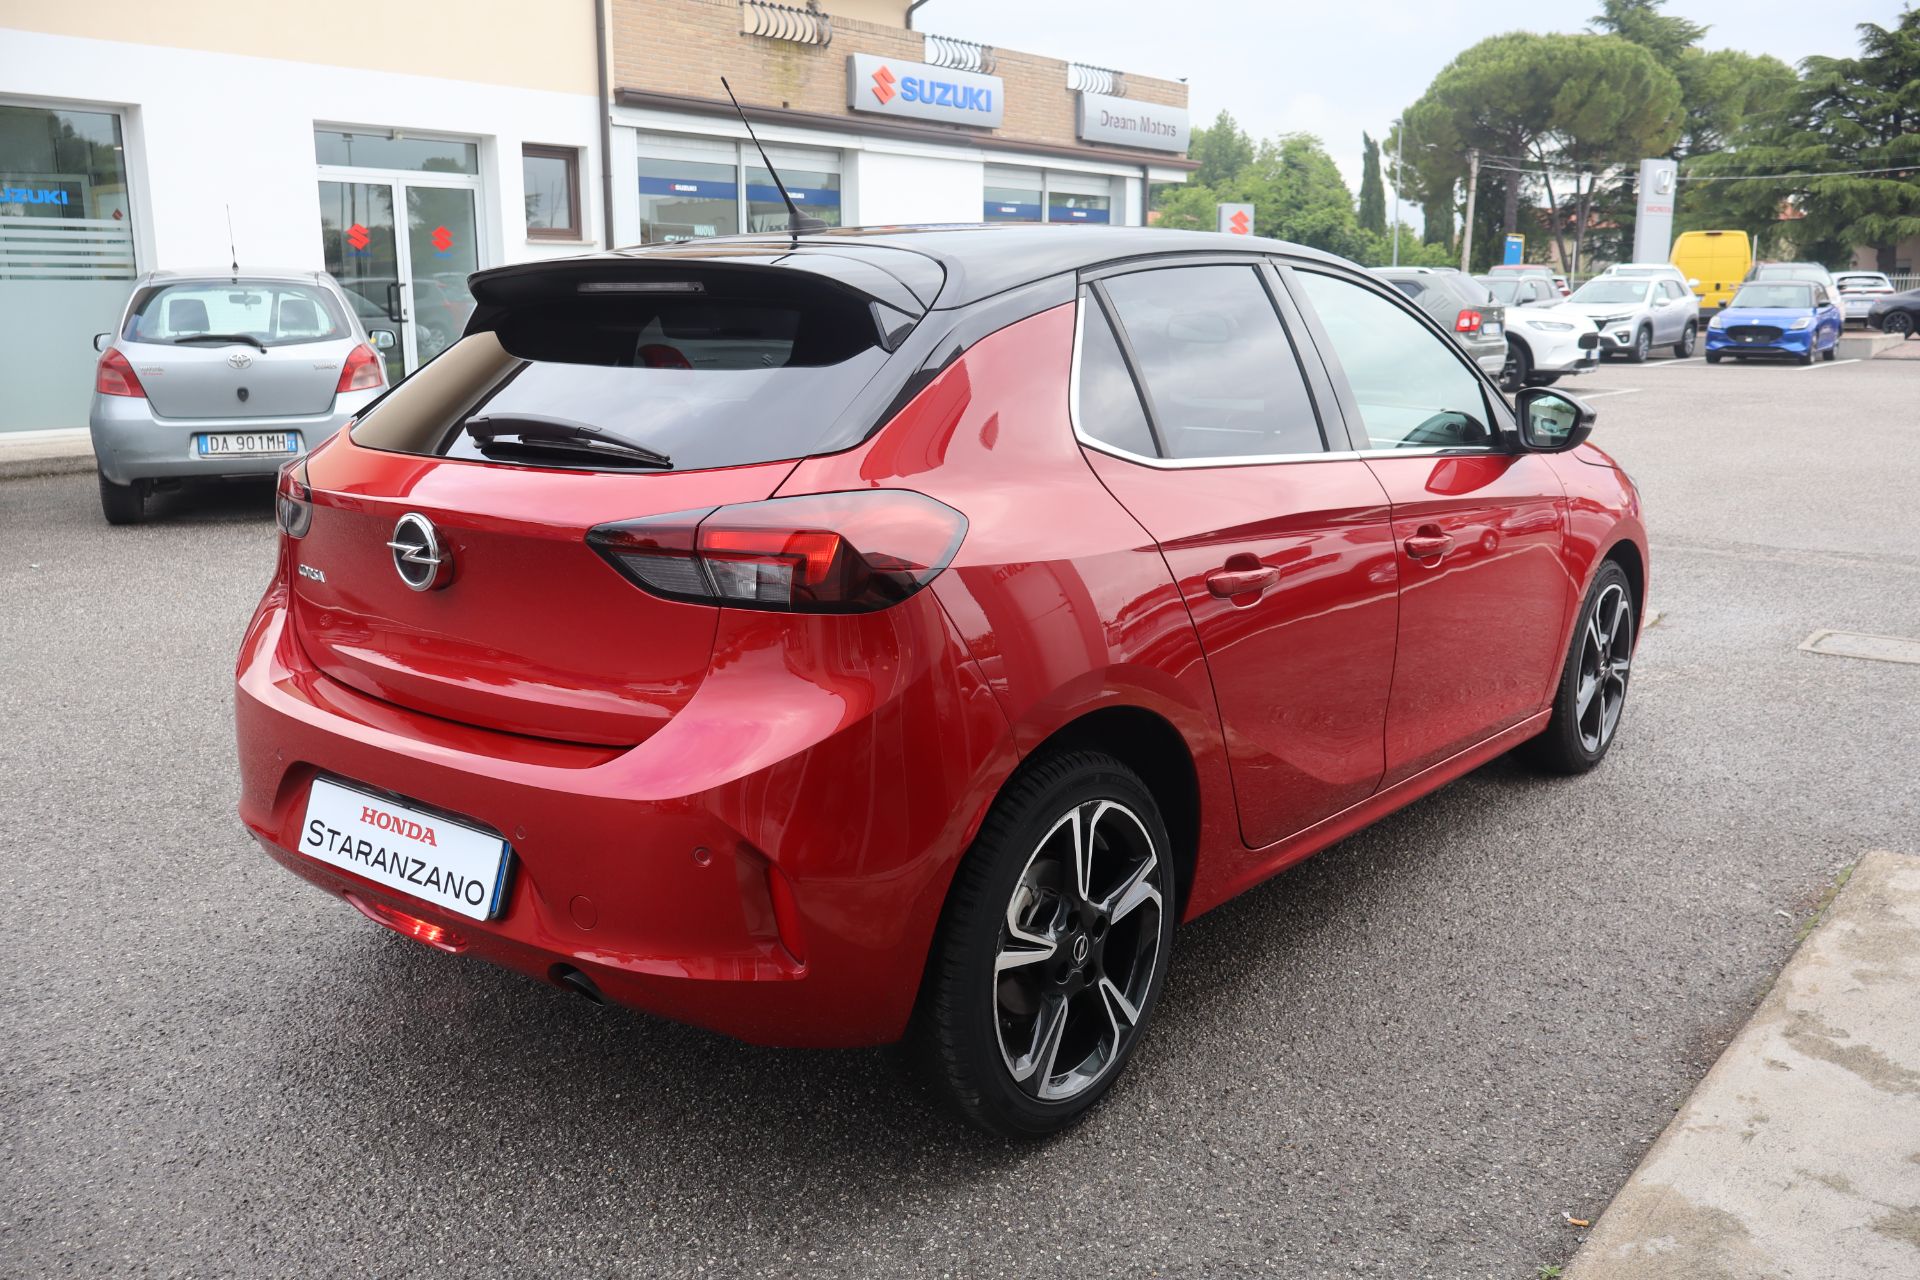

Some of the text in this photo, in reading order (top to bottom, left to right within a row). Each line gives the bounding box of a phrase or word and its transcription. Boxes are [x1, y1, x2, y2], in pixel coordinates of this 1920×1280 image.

[901, 76, 992, 112] SUZUKI
[1100, 109, 1177, 137] Dream Motors
[694, 224, 715, 237] NUOVA
[210, 436, 229, 451] DA
[236, 434, 286, 450] 901MH
[359, 806, 437, 847] HONDA
[307, 819, 485, 906] STARANZANO
